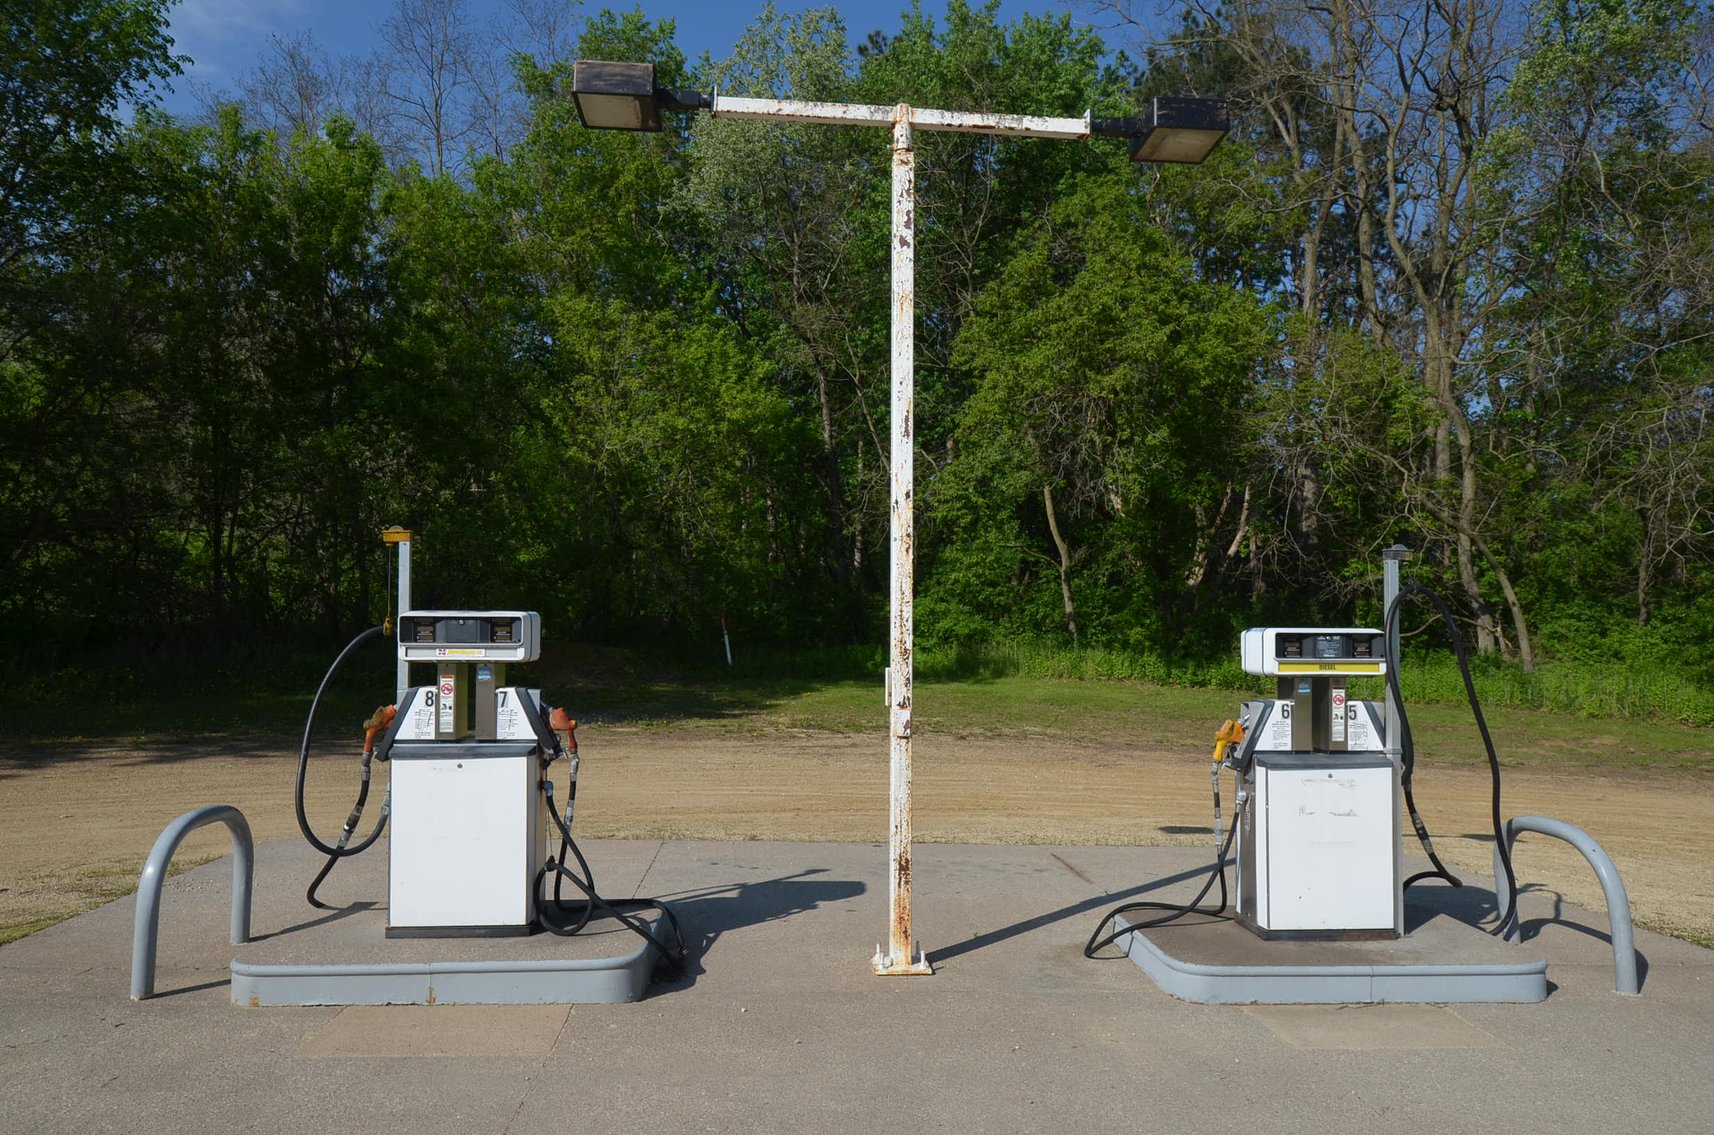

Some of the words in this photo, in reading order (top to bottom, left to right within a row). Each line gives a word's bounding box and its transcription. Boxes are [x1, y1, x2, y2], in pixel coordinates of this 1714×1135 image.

[425, 690, 435, 707] 8
[499, 691, 508, 708] 7
[1281, 703, 1290, 719] 6
[1349, 704, 1357, 720] 5
